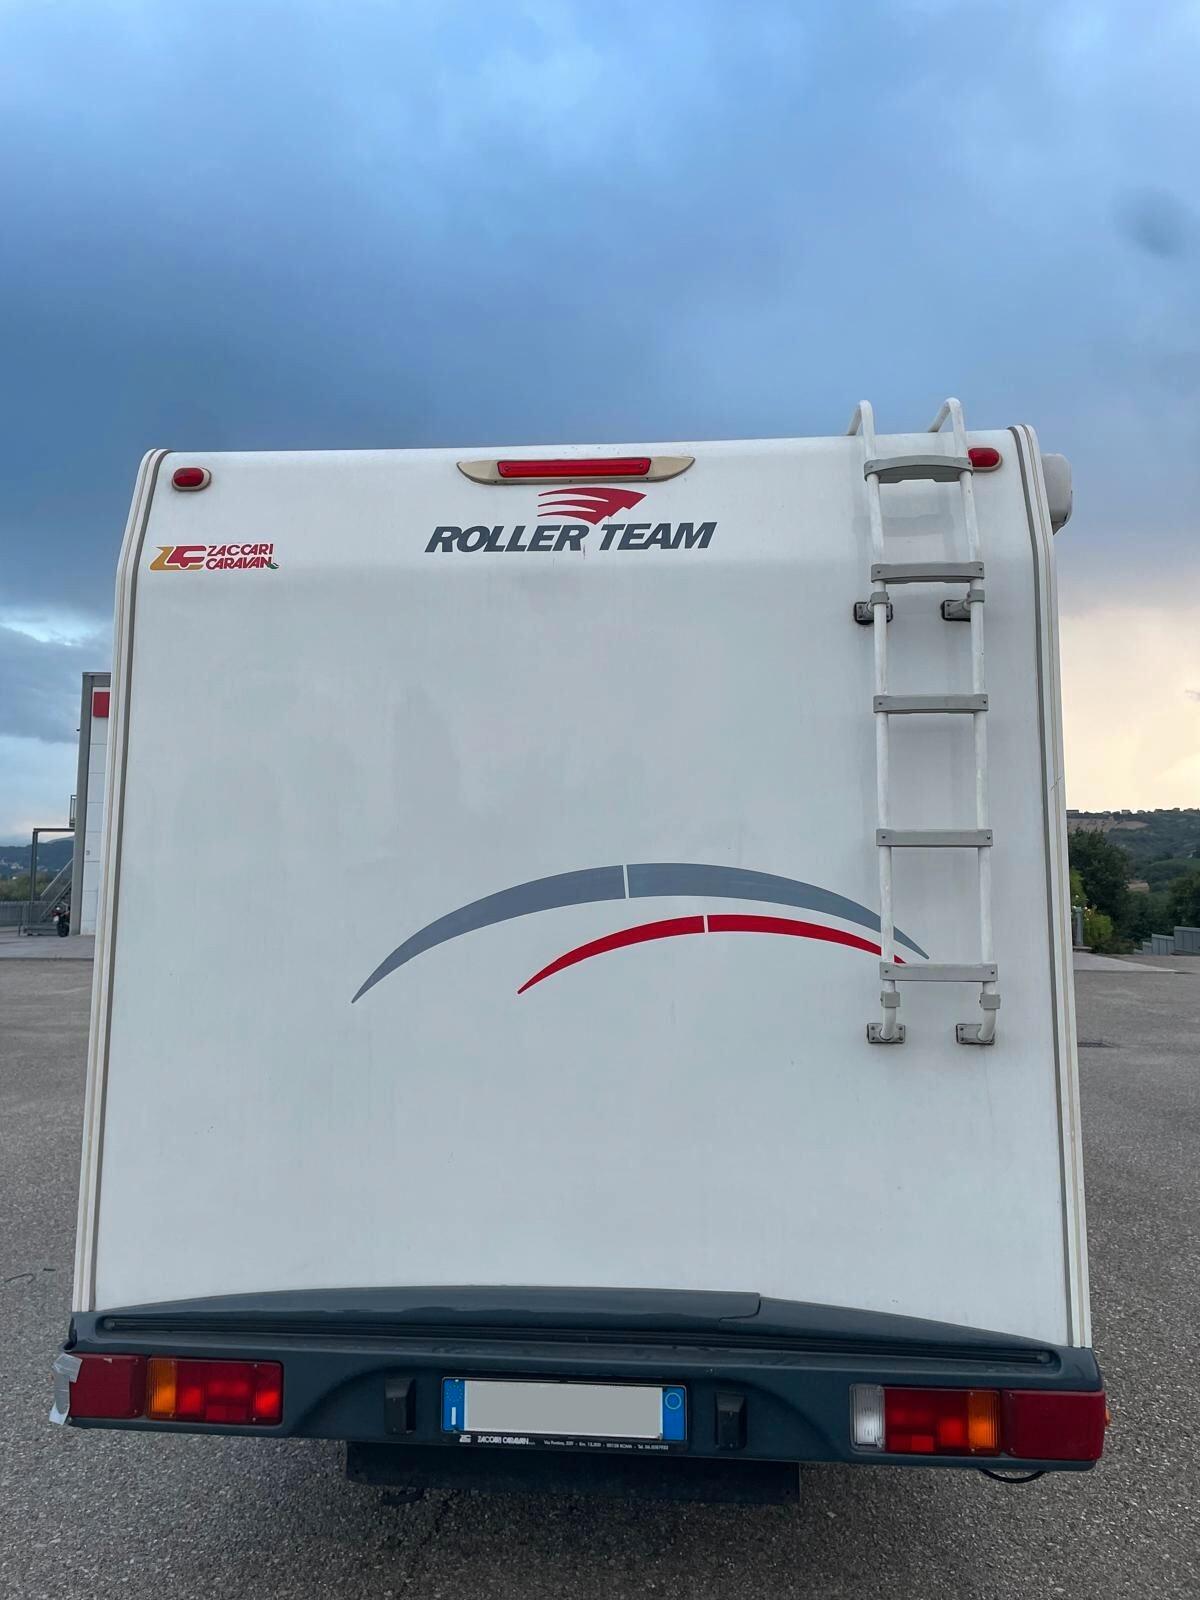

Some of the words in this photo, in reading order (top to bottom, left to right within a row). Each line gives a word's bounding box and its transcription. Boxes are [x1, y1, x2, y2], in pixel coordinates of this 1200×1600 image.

[424, 524, 590, 553] ROLLER
[599, 521, 717, 551] TEAM
[207, 543, 274, 557] ZACCARI
[205, 556, 272, 570] CARAVAN
[451, 1406, 457, 1426] I
